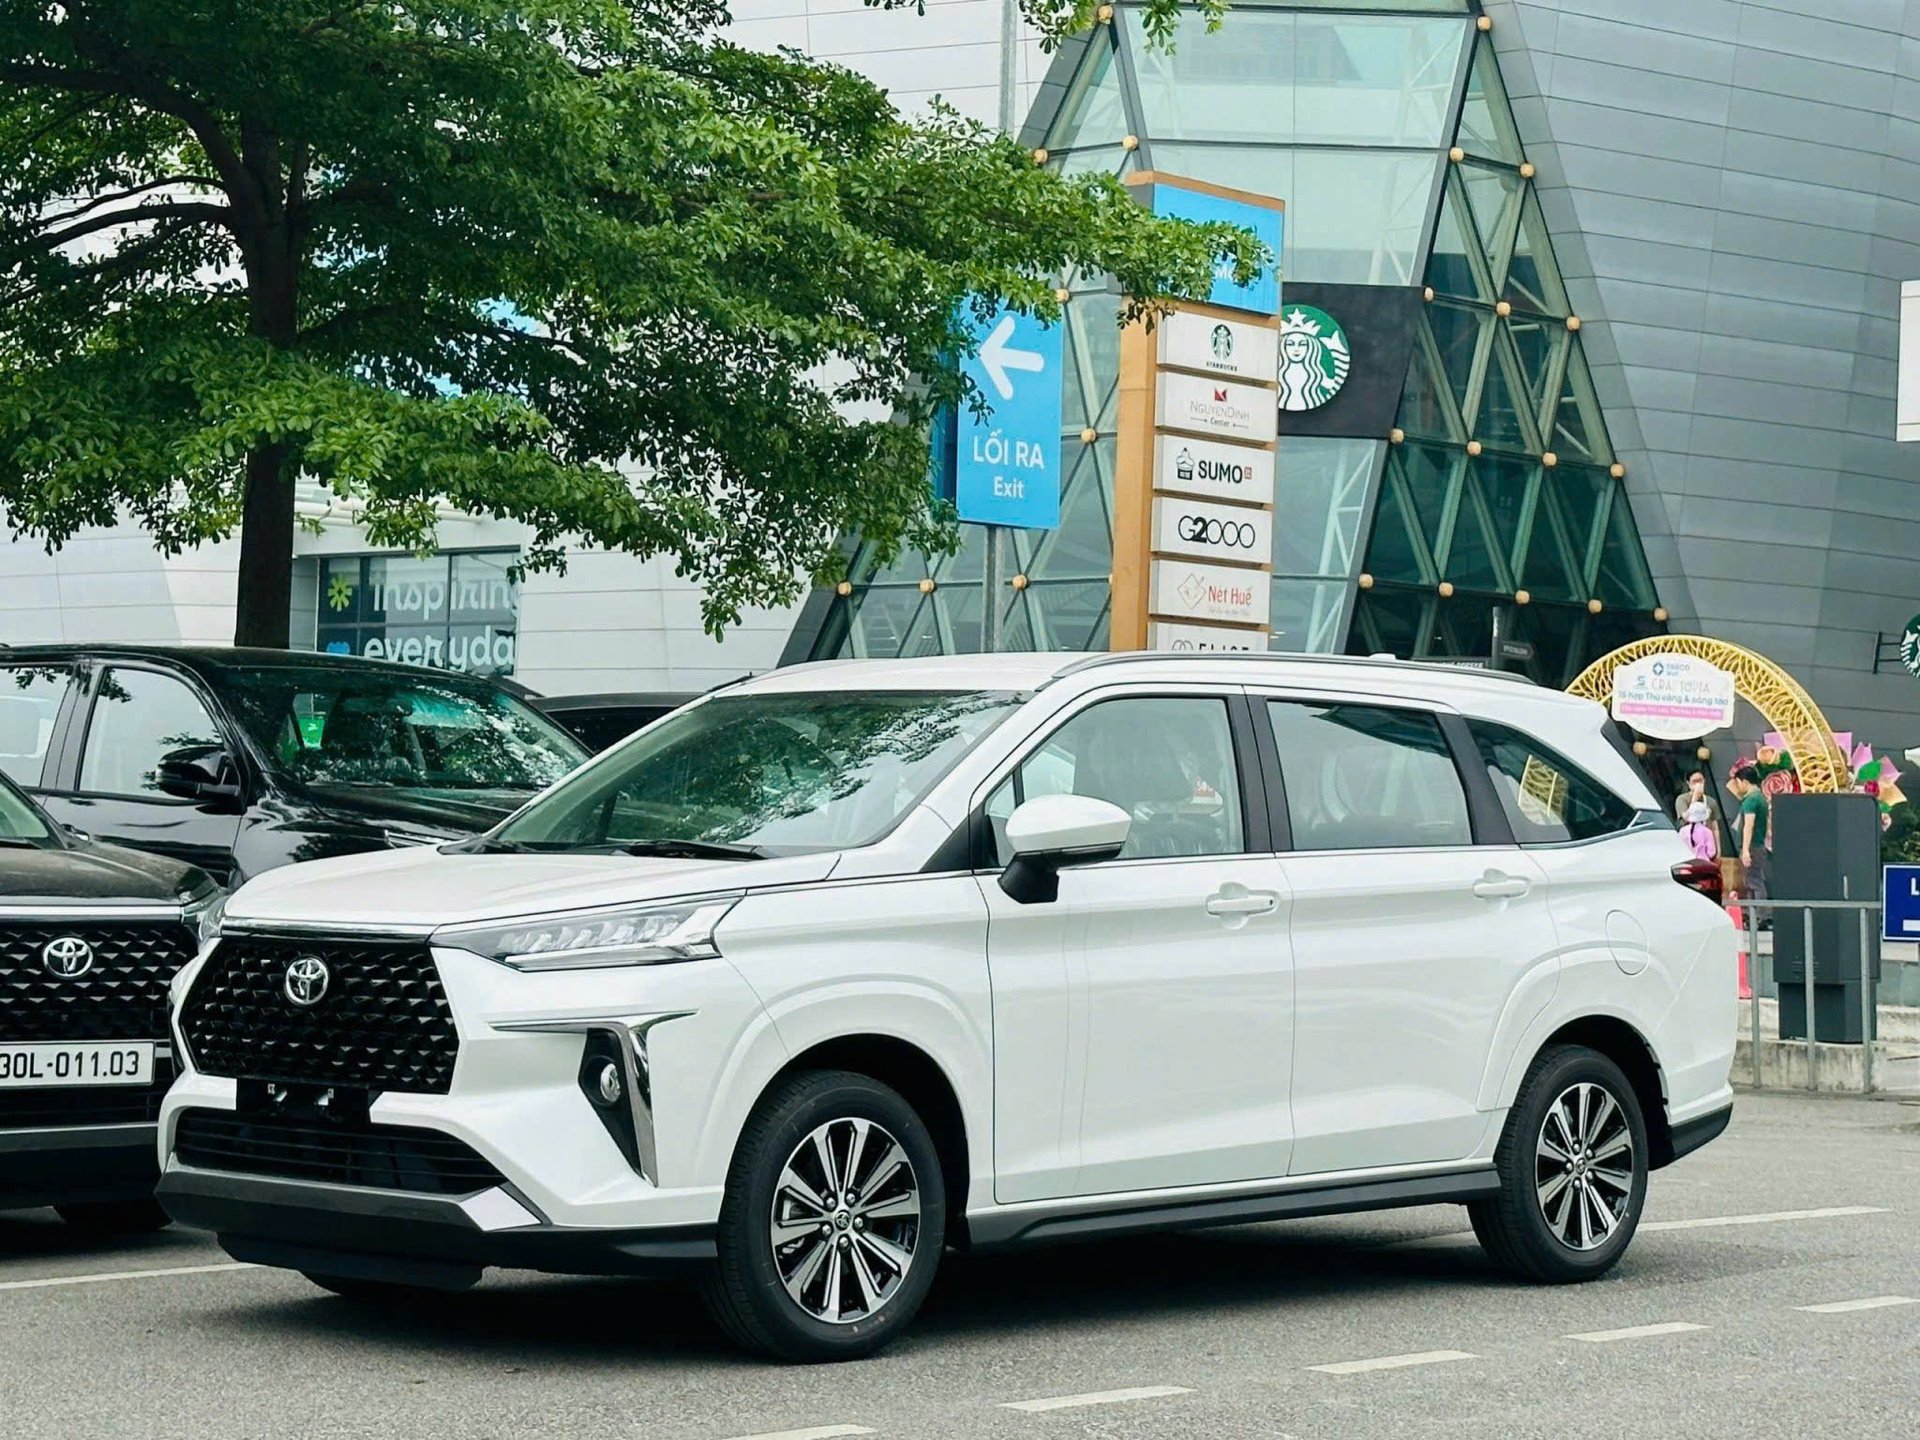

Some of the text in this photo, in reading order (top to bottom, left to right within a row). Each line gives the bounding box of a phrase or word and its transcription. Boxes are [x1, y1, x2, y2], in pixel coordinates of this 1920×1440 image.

[973, 429, 1045, 469] LỐI RA
[1198, 460, 1243, 484] SUMO
[993, 476, 1025, 499] Exit
[1178, 515, 1256, 549] G2000
[0, 1051, 139, 1079] 30L-011.03
